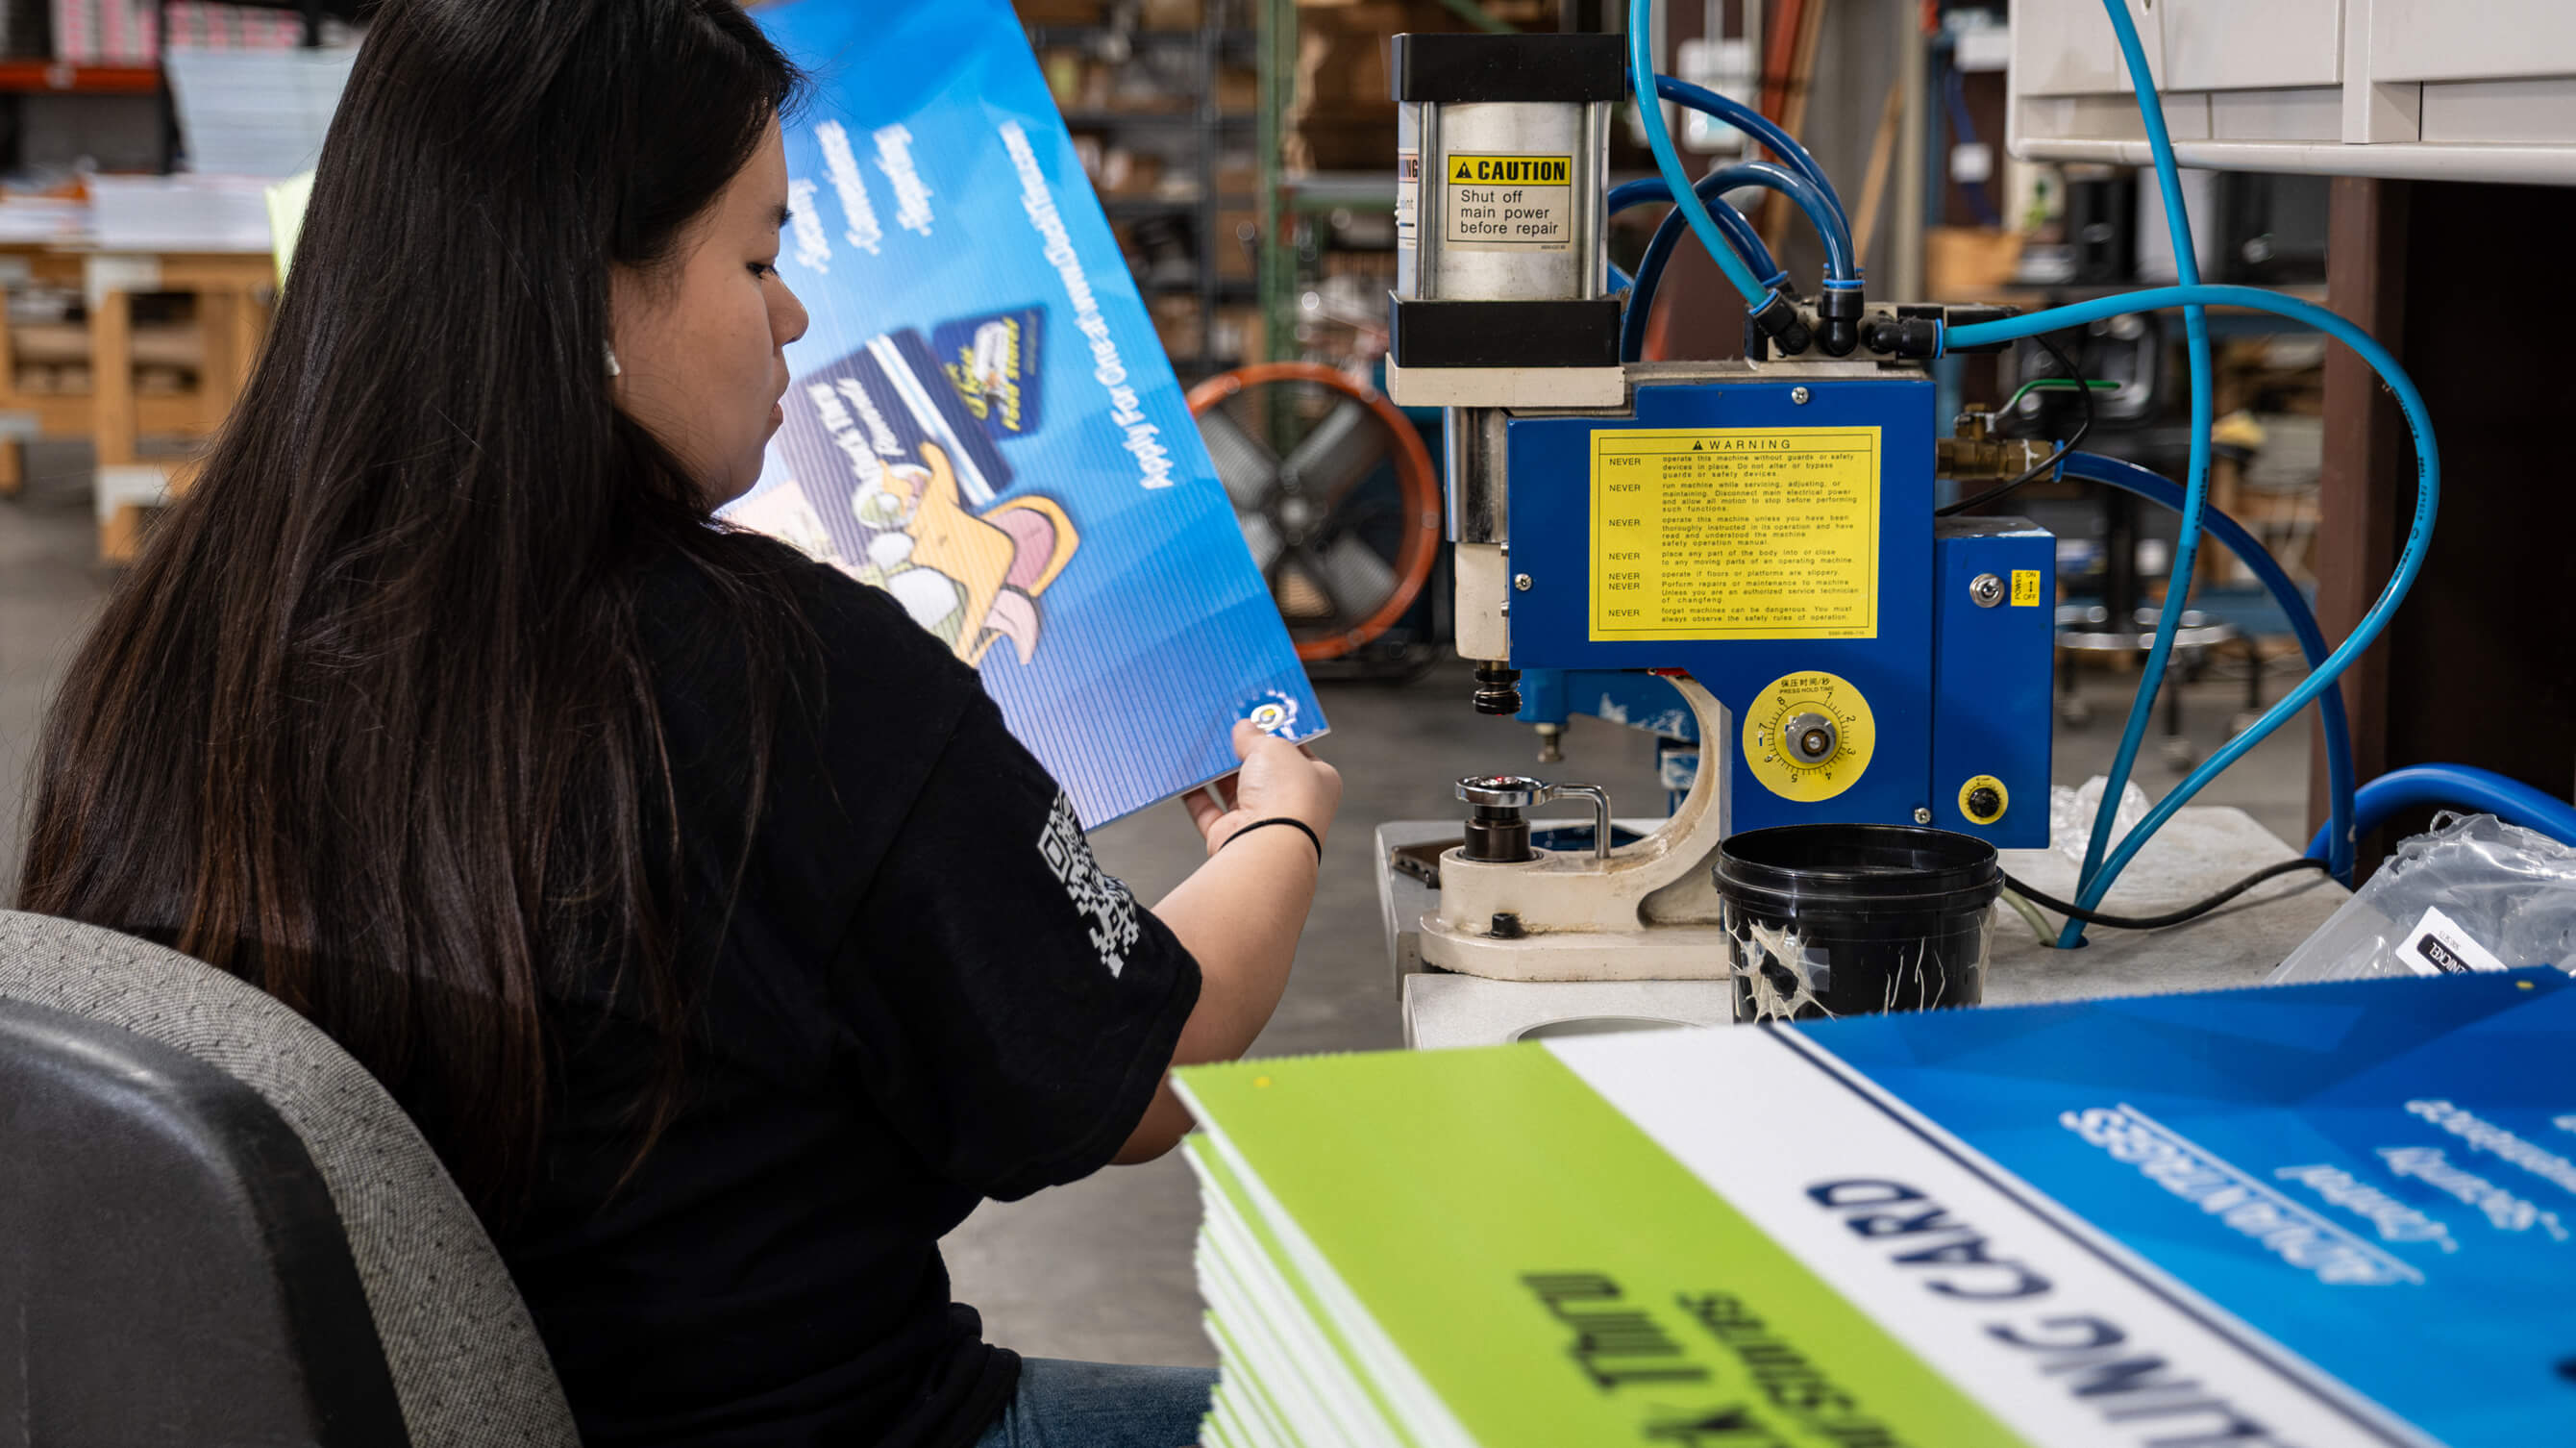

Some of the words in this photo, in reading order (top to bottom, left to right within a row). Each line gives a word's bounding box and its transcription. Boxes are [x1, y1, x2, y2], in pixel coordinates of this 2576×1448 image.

[1478, 161, 1566, 180] CAUTION
[1460, 189, 1495, 203] Shut
[1502, 190, 1523, 203] off
[1460, 207, 1496, 218] main
[1504, 208, 1549, 221] power
[1460, 221, 1508, 235] before
[1516, 222, 1558, 237] repair
[1710, 439, 1791, 450] WARNING
[1805, 1177, 2055, 1300] CARD
[1979, 1313, 2272, 1448] LING
